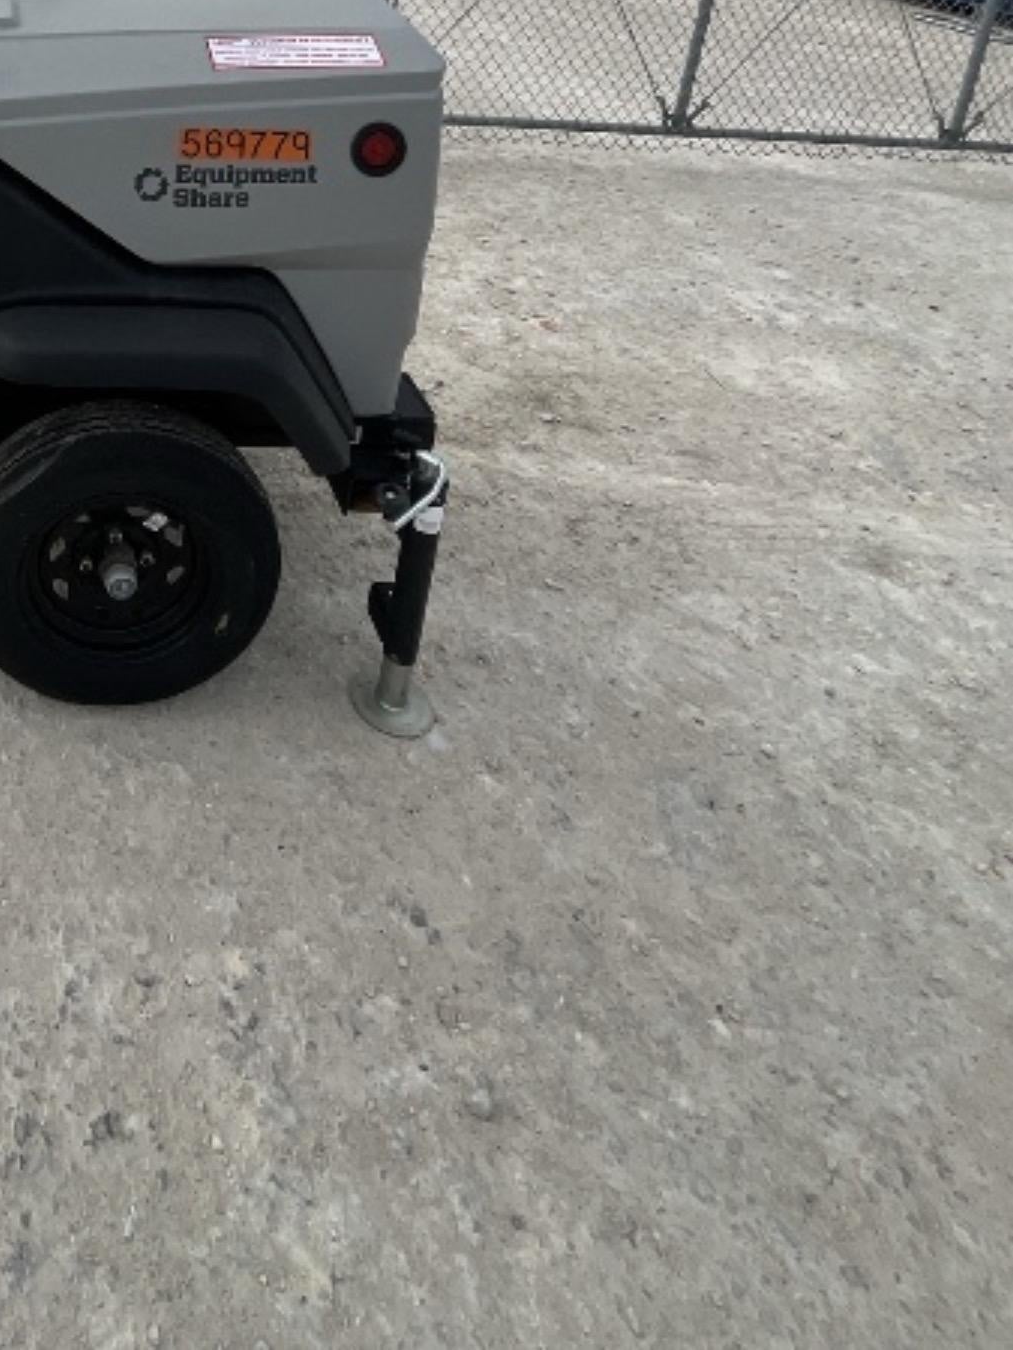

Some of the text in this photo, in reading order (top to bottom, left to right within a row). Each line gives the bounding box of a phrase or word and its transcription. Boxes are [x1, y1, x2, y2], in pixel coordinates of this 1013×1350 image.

[181, 128, 310, 160] 569779
[175, 164, 318, 188] Equipment
[173, 189, 249, 208] Share
